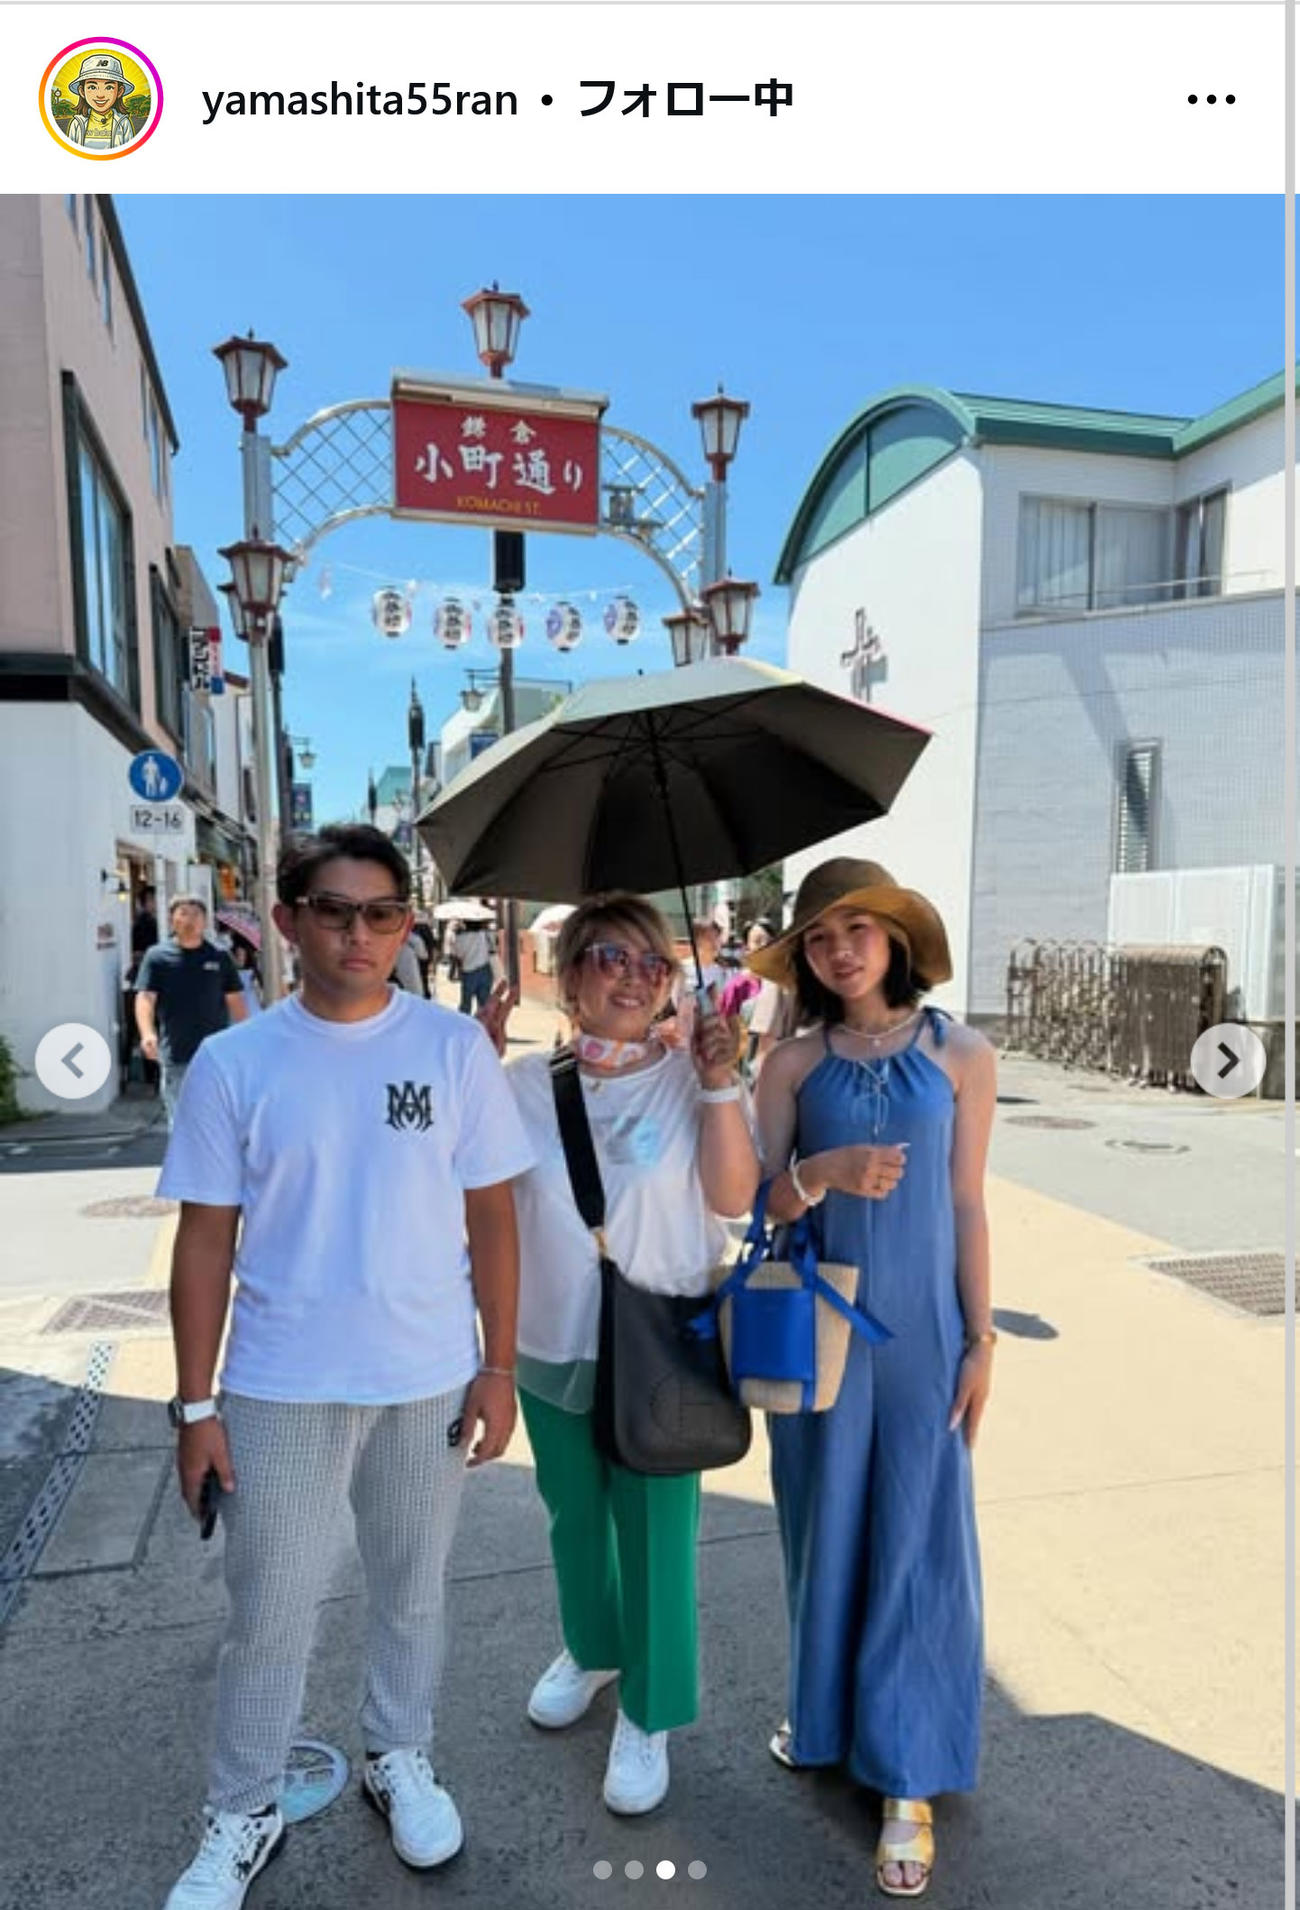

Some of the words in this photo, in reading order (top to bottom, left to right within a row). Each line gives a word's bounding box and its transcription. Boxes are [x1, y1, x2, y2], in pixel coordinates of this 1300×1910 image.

[415, 442, 584, 495] 小町通り
[134, 807, 183, 829] 12-16
